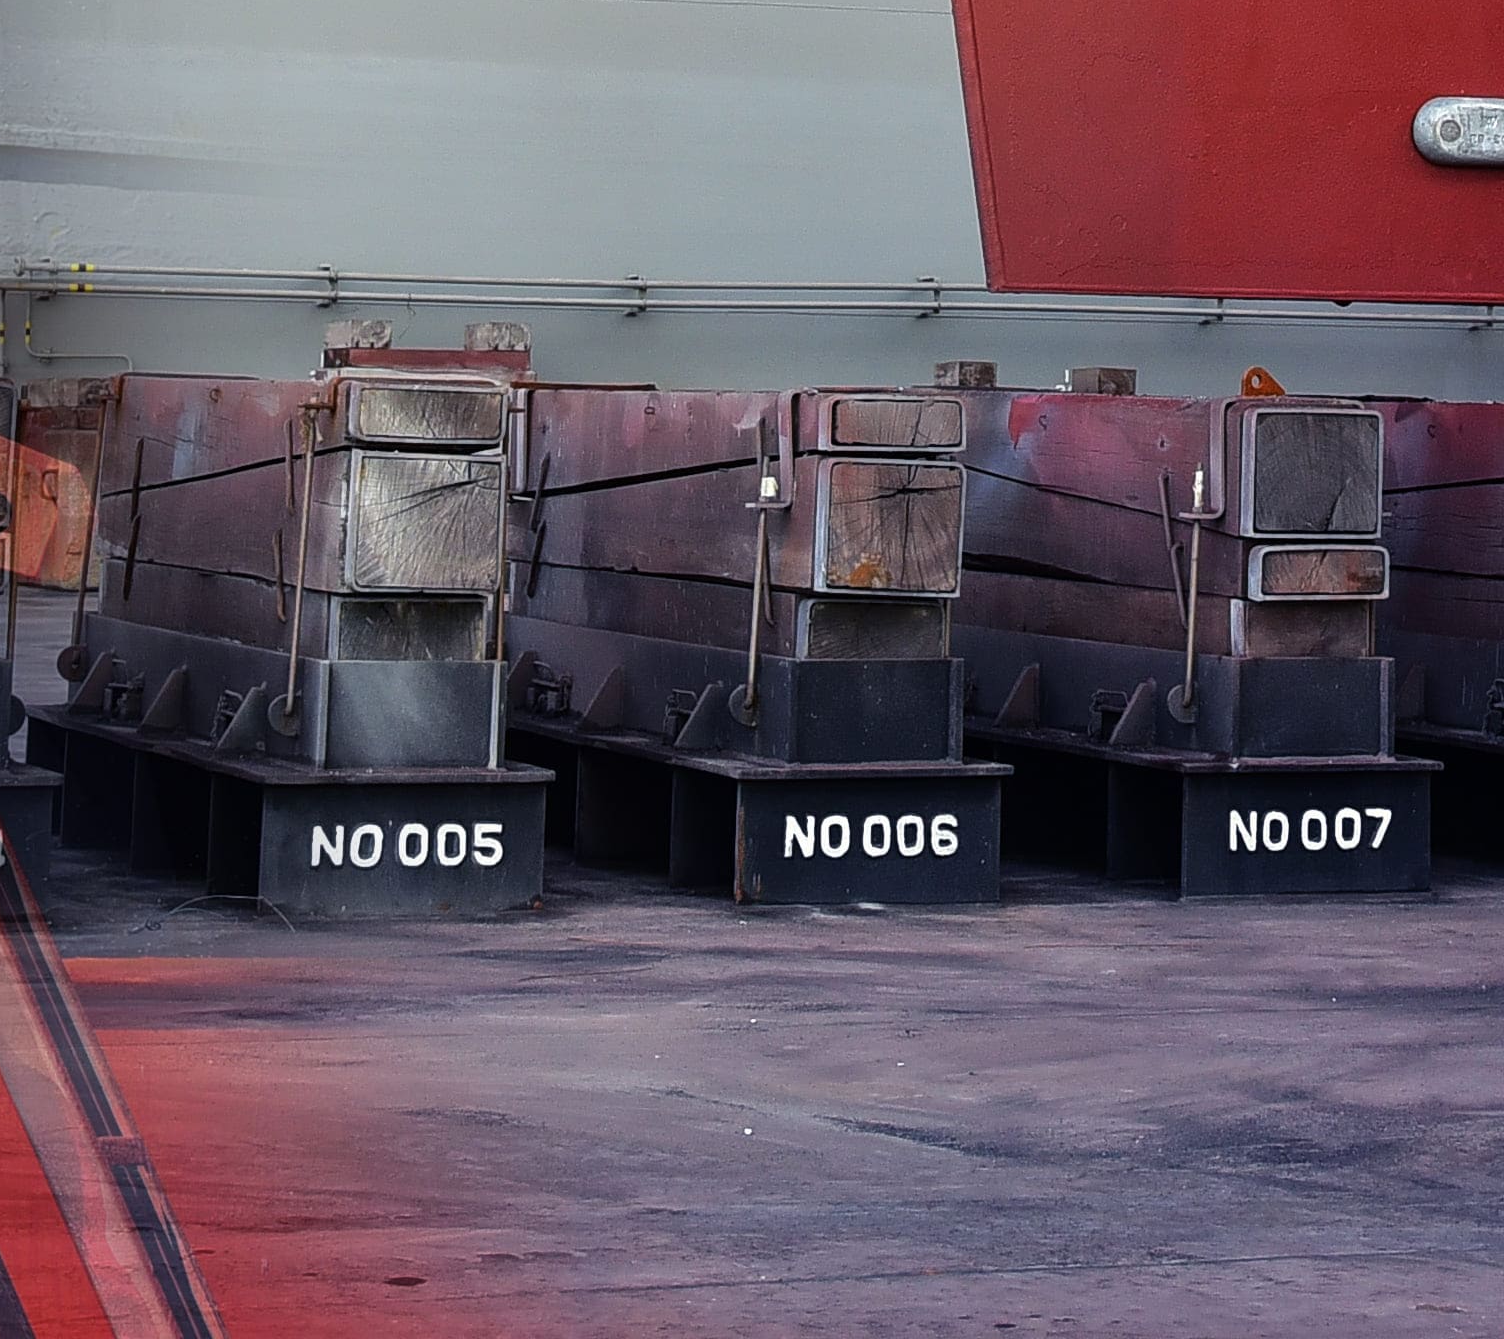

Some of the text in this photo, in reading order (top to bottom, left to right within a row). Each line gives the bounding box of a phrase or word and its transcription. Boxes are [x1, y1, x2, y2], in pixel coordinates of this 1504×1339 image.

[310, 822, 504, 868] NO 005
[783, 813, 959, 858] NO 006
[1229, 807, 1393, 852] NO 007
